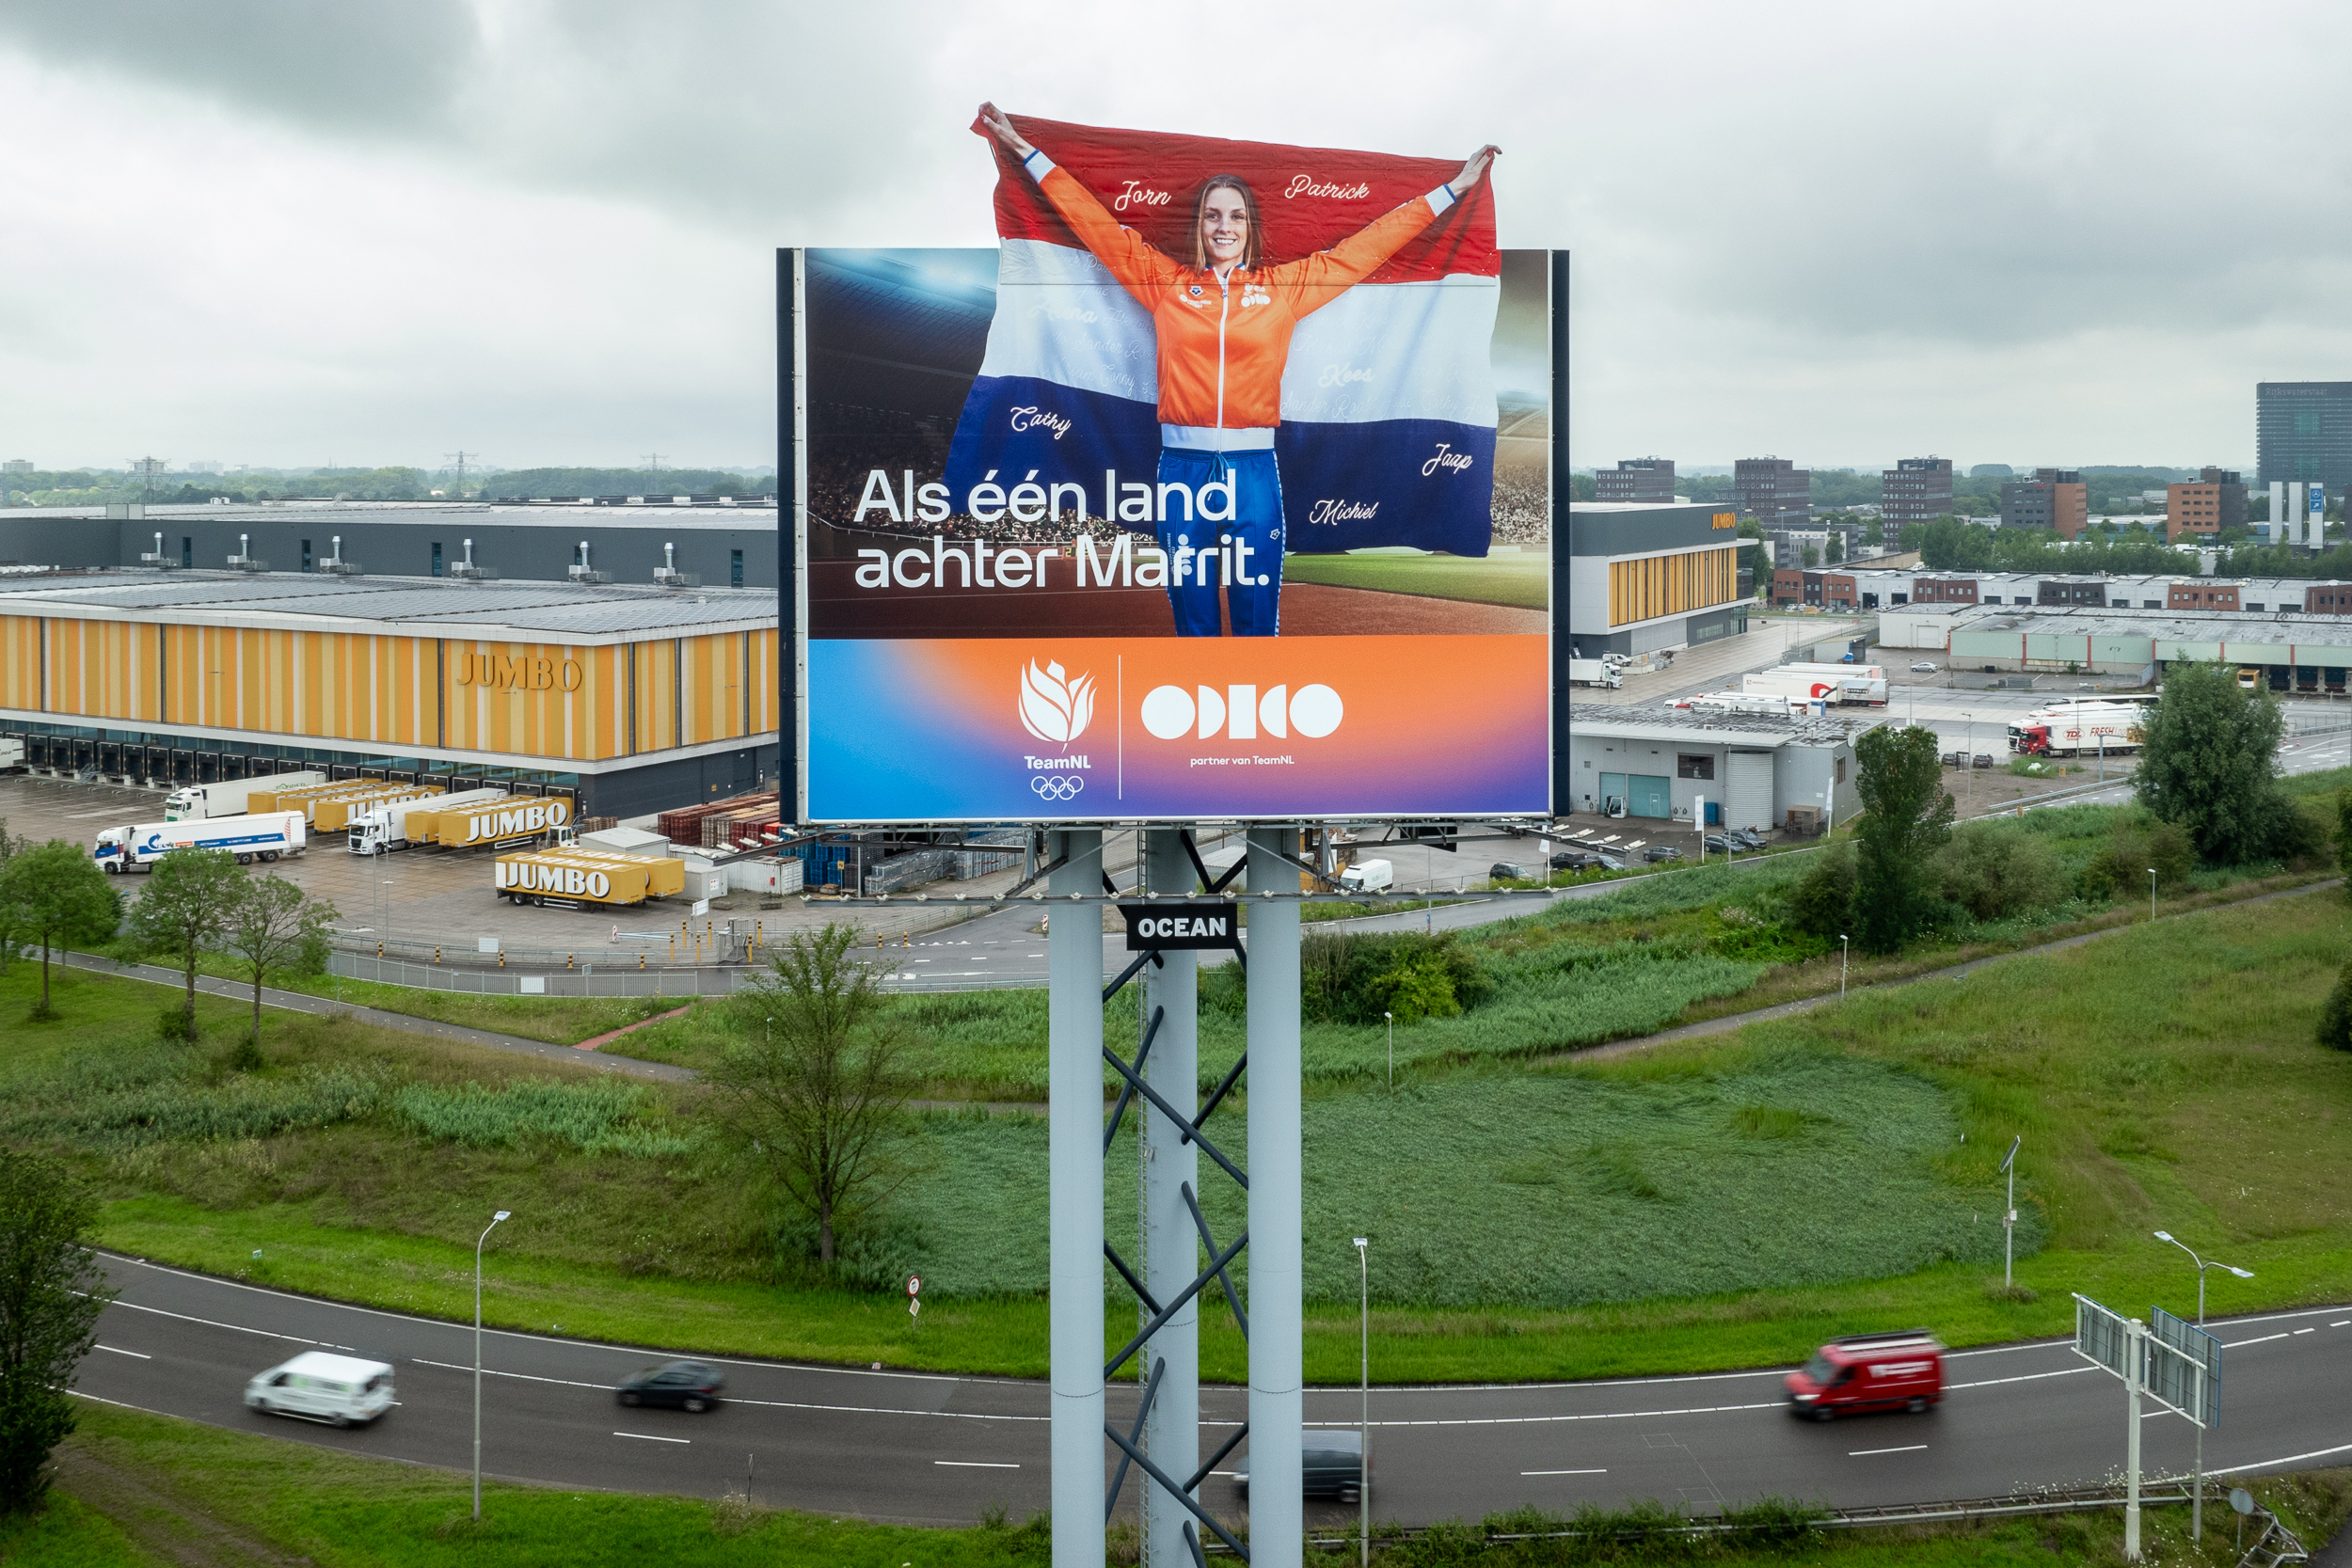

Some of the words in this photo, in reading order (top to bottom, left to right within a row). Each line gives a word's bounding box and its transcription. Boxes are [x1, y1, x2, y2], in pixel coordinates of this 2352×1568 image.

[1114, 181, 1171, 211] Jorn
[1285, 174, 1370, 199] Patrick
[1318, 361, 1376, 388] Kees
[1009, 405, 1072, 440] Cathy
[1422, 443, 1474, 477] Jaap
[853, 469, 950, 523] Als
[967, 469, 1087, 523] één
[1106, 468, 1236, 522] land
[1309, 499, 1379, 526] Michiel
[1710, 512, 1737, 531] JUMBO
[855, 535, 1057, 588] achter
[1076, 534, 1270, 588] Marrit.
[457, 654, 582, 692] JUMBO
[1024, 754, 1091, 769] TeamNL
[1190, 756, 1227, 768] partner
[1229, 756, 1251, 766] van
[1252, 754, 1295, 766] TeamNL
[466, 801, 567, 842] JUMBO
[507, 862, 612, 898] JUMBO
[1137, 917, 1227, 938] OCEAN
